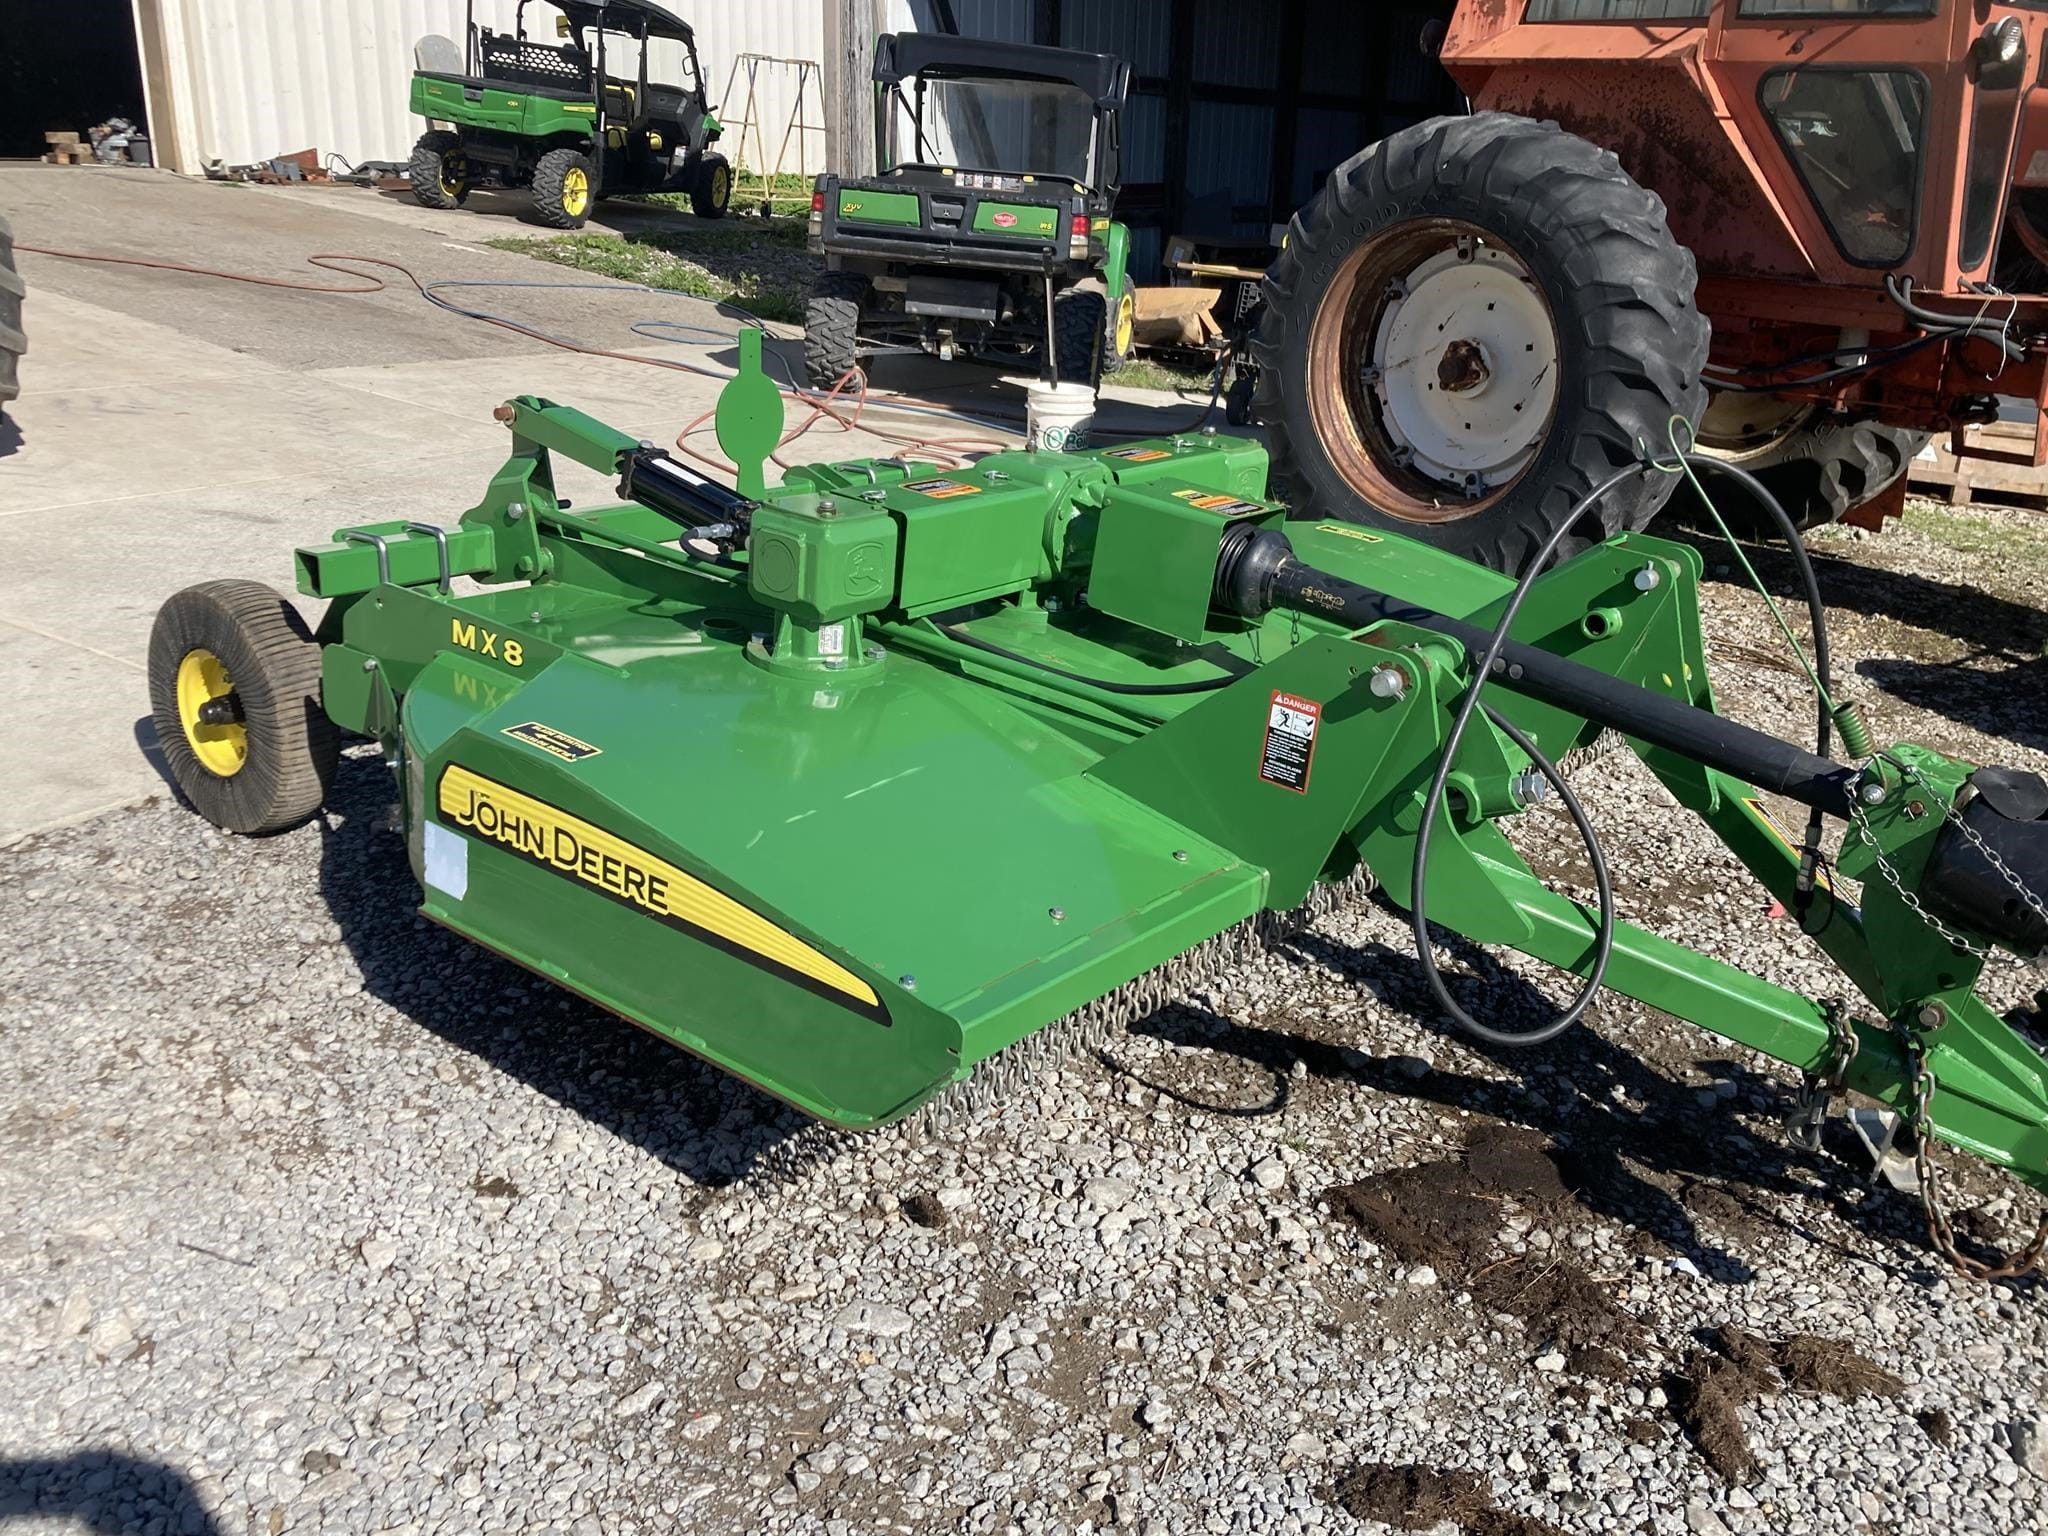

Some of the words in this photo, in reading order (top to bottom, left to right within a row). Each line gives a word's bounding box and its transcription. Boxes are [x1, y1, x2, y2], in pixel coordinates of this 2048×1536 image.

[845, 202, 863, 210] XUV
[1283, 697, 1317, 714] DANGER
[459, 789, 544, 855] JOHN
[554, 826, 669, 910] DEERE
